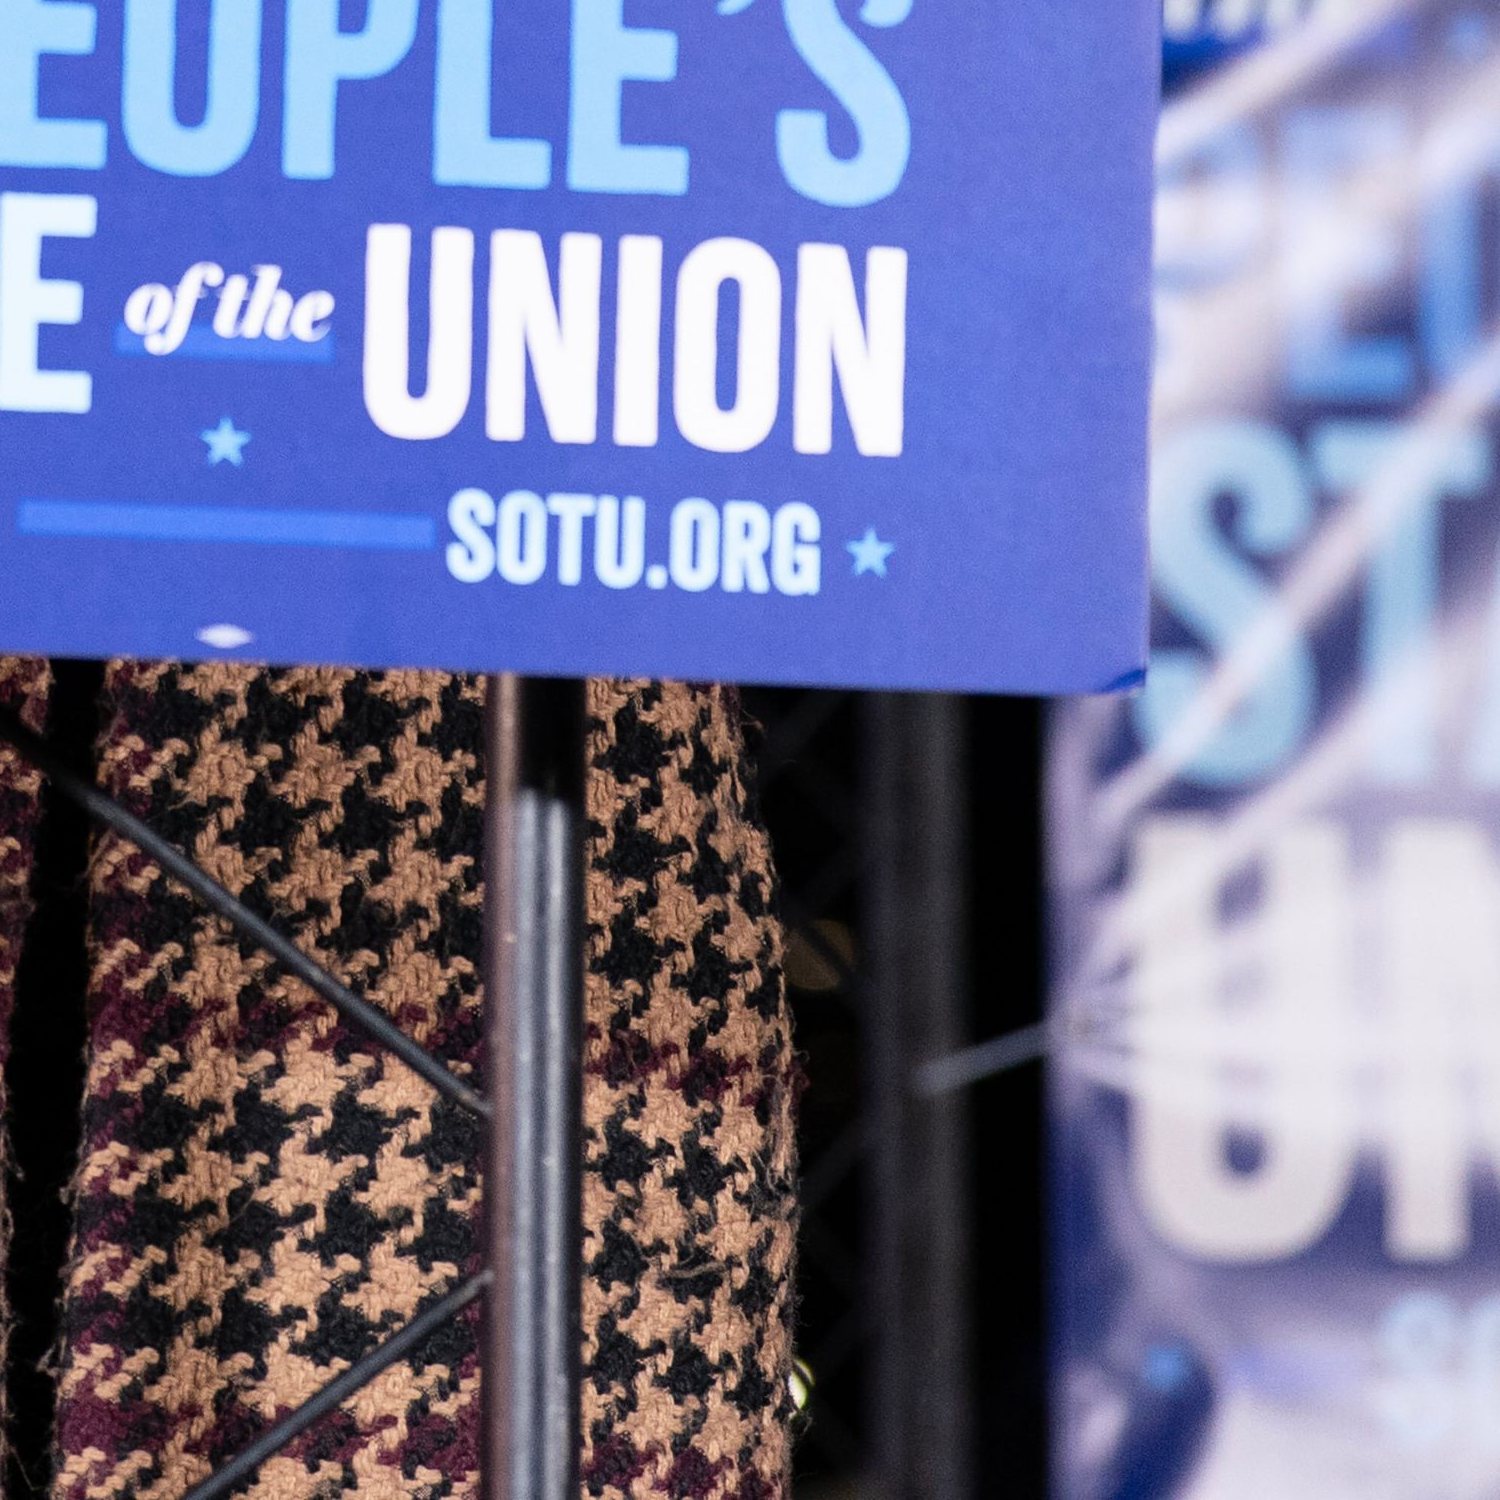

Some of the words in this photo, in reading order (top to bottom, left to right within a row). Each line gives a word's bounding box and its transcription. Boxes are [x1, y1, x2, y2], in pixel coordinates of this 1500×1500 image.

[123, 261, 223, 356] of
[215, 263, 336, 343] the
[363, 222, 909, 458] UNION
[445, 486, 822, 596] SOTU.ORG
